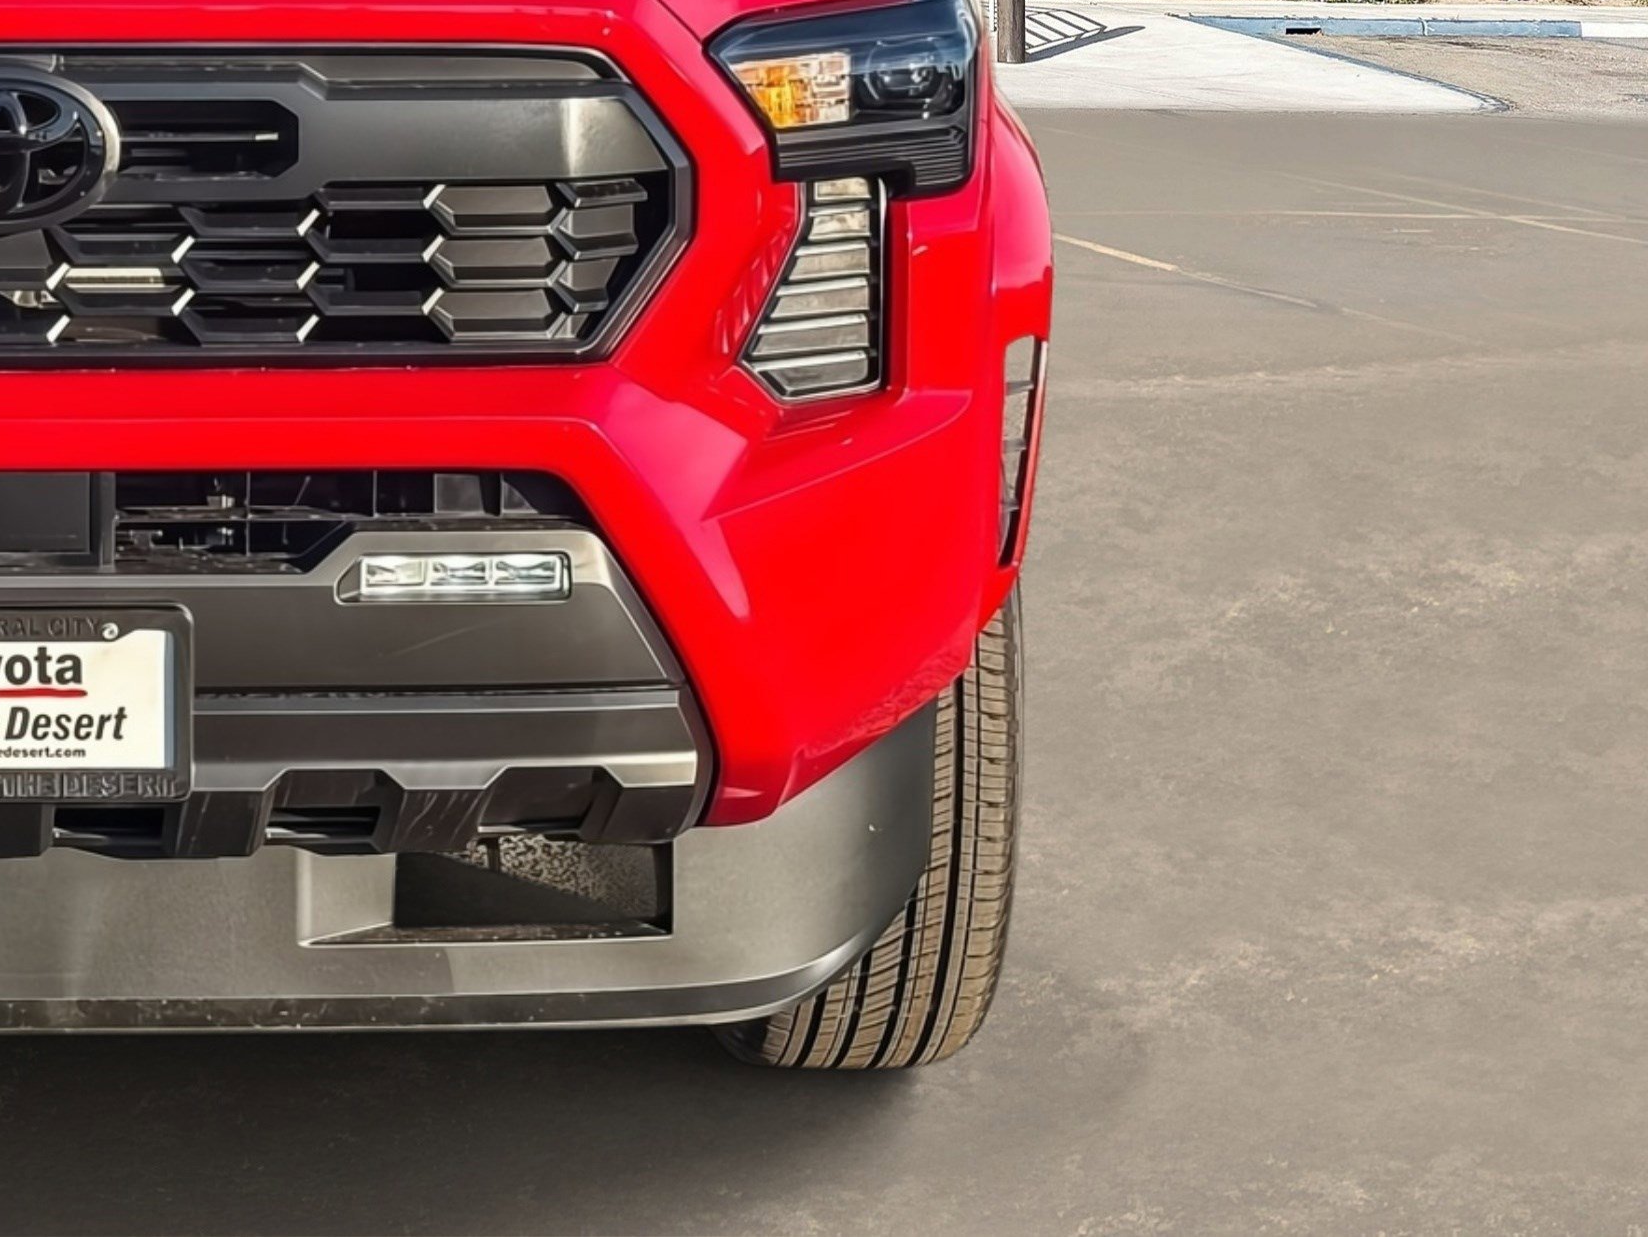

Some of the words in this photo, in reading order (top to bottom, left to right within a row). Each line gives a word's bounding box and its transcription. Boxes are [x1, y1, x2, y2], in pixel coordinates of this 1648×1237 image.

[47, 617, 99, 637] CITY
[5, 705, 128, 741] Desert
[63, 774, 179, 798] DESERT
